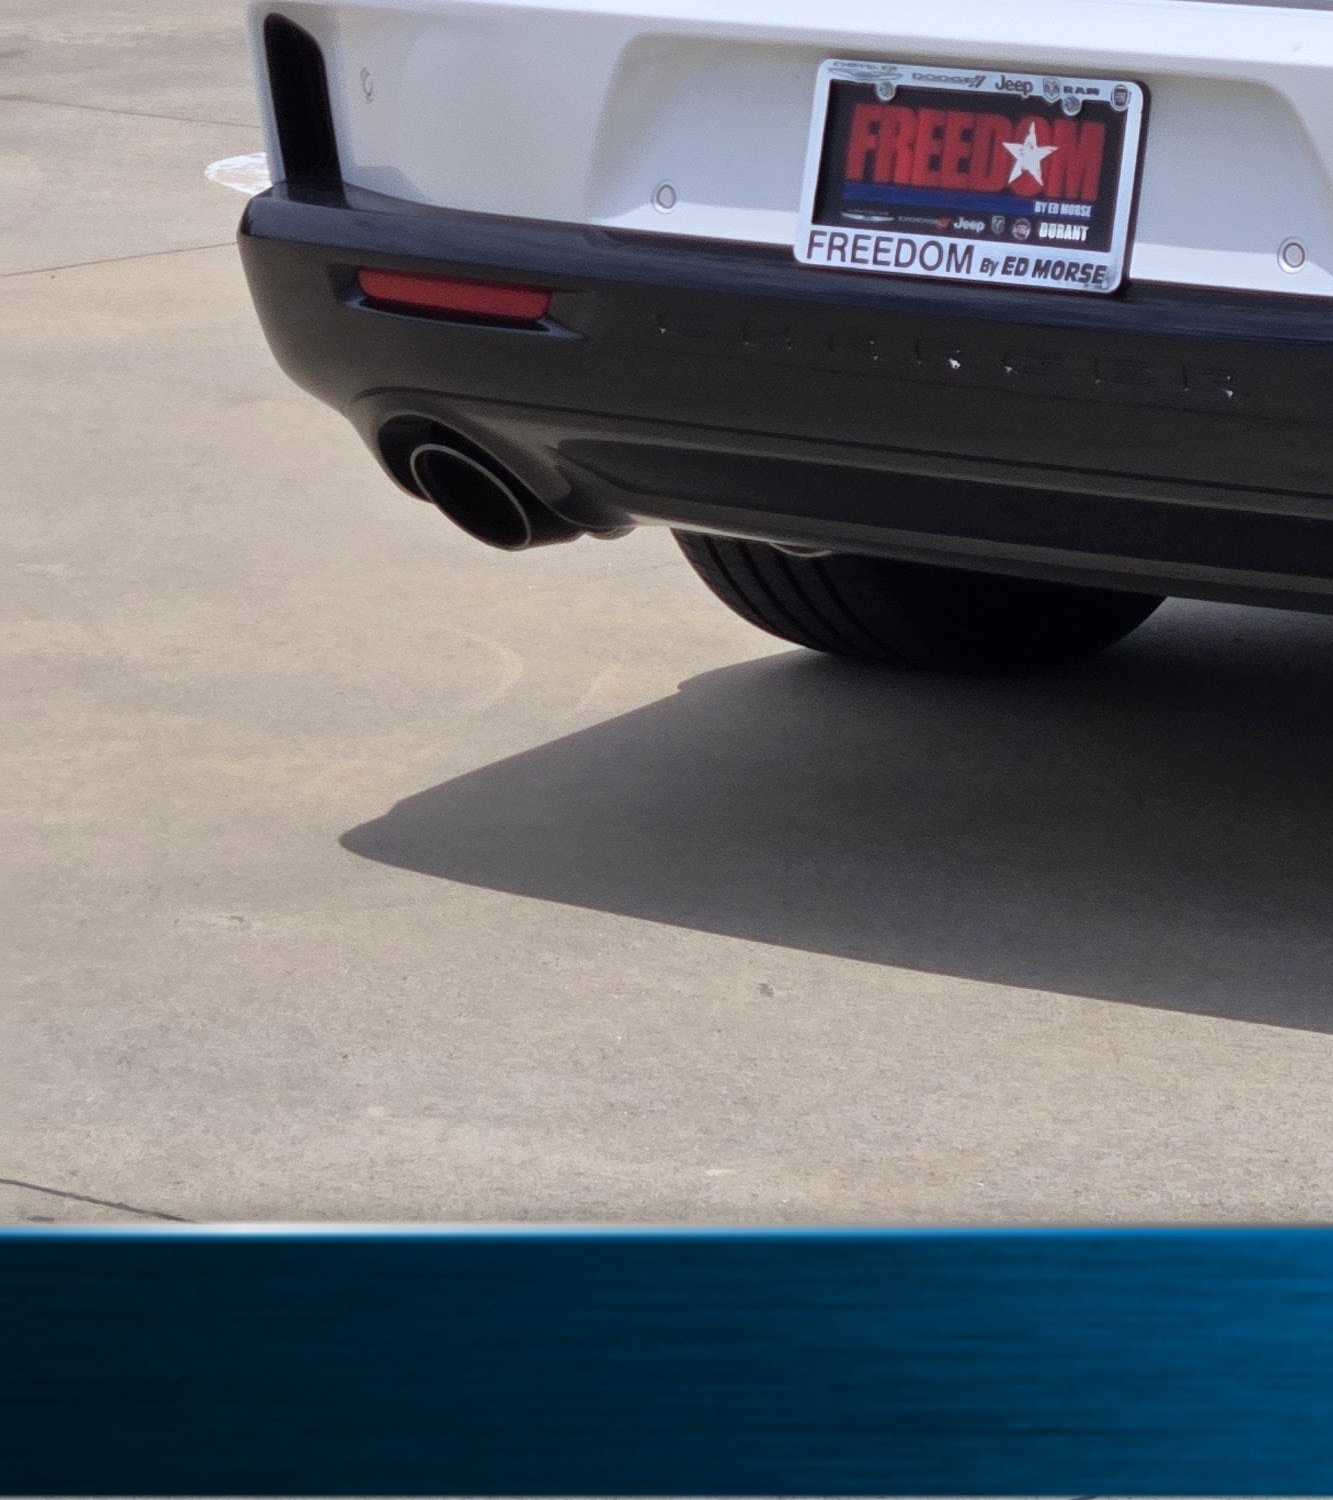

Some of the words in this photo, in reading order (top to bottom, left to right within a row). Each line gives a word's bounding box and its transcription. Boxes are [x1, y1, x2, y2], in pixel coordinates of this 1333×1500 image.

[995, 75, 1033, 96] Jeep
[1063, 85, 1100, 96] RAM
[845, 103, 1107, 201] FREEDOM
[1034, 200, 1048, 214] BY
[1048, 202, 1060, 215] ED
[1060, 203, 1092, 218] MORSE
[953, 216, 986, 234] Jeep
[1039, 221, 1090, 242] DURANT
[806, 230, 975, 275] FREEDOM
[1001, 255, 1030, 277] ED
[1031, 258, 1108, 285] MORSE
